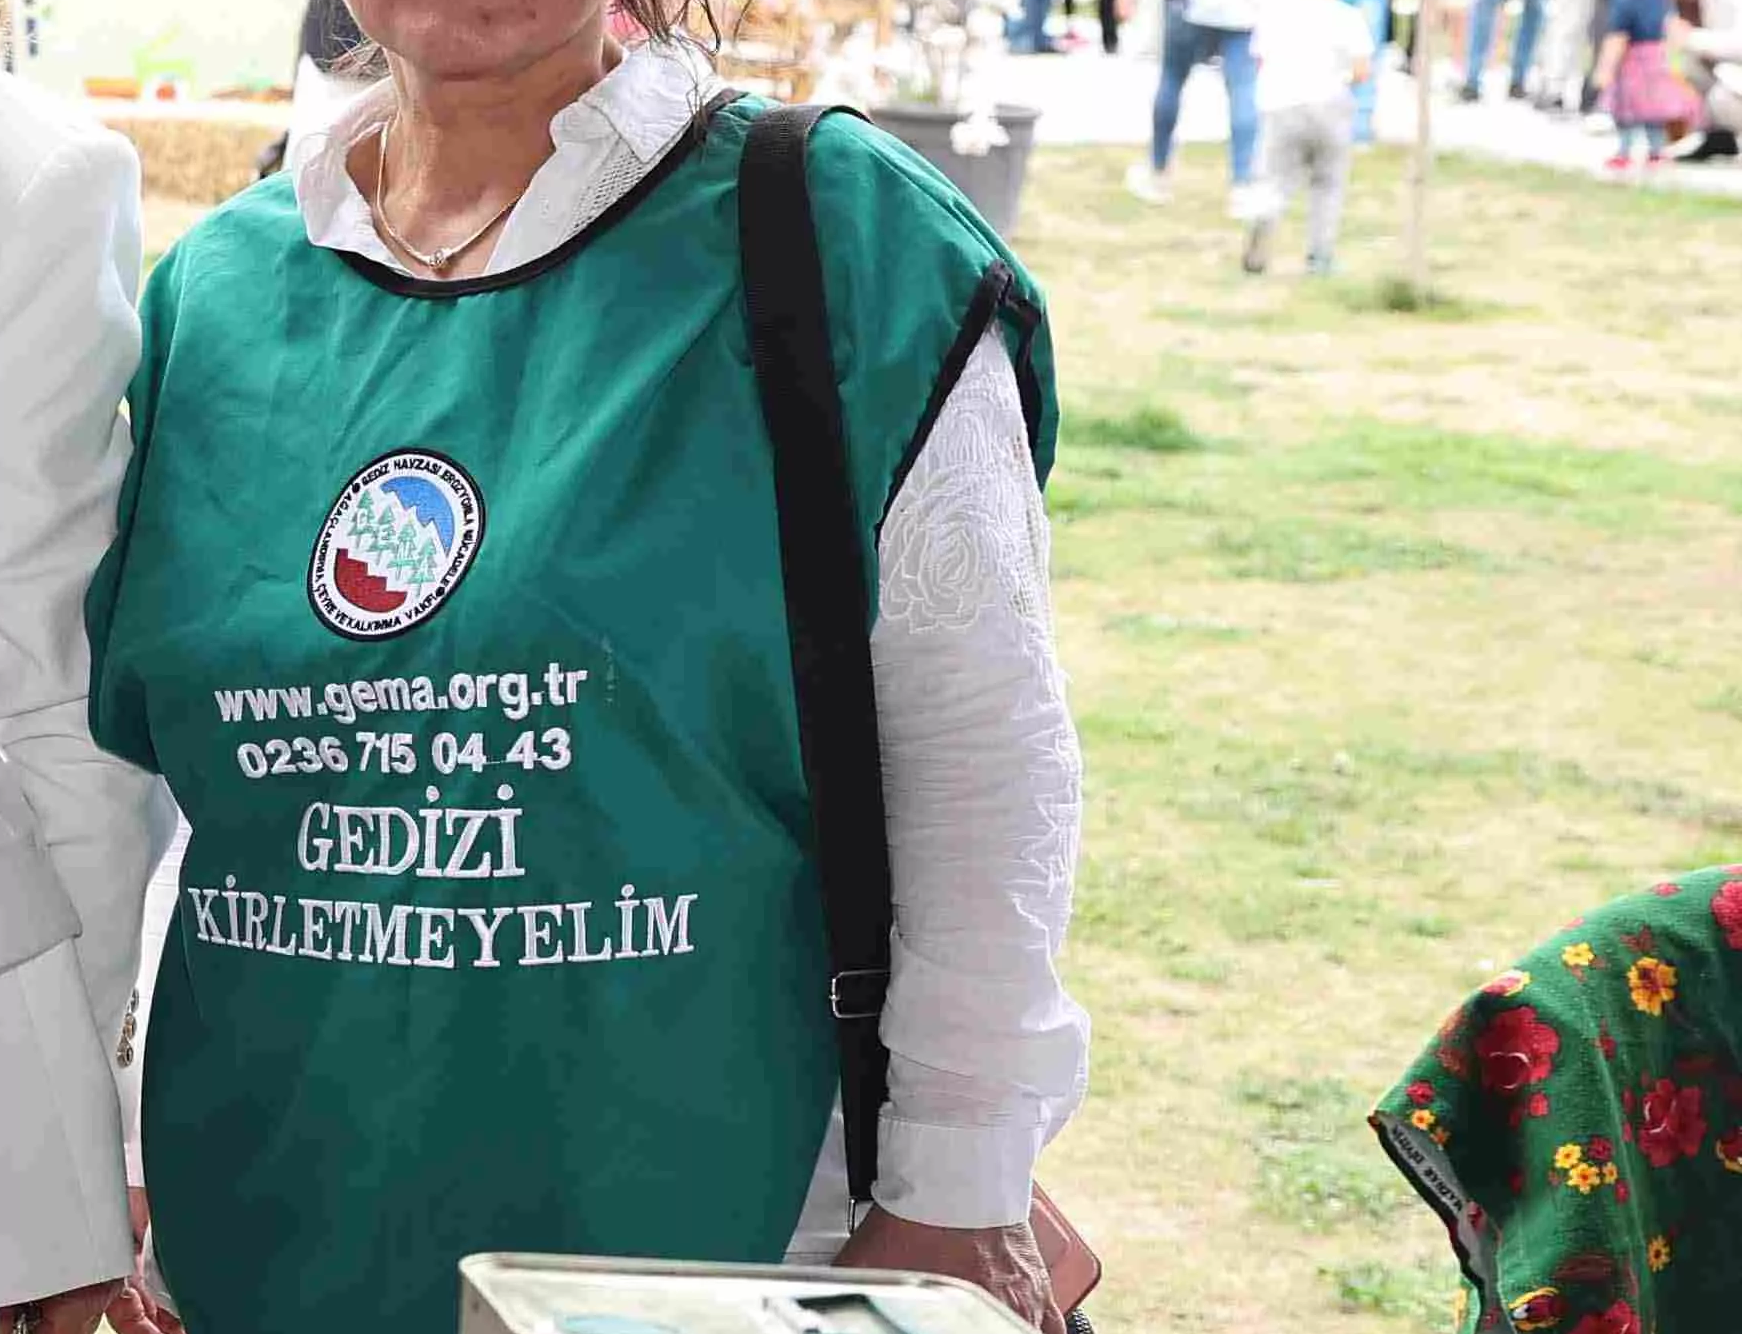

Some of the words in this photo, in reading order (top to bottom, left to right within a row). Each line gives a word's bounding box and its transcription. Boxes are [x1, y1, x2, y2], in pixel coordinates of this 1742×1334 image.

[214, 662, 588, 725] www.gema.org.tr
[237, 736, 349, 779] 0236
[355, 731, 417, 773] 715
[431, 732, 487, 773] 04
[506, 727, 572, 770] 43
[297, 784, 526, 879] GEDİZİ
[187, 874, 699, 969] KİRLETMEYELİM
